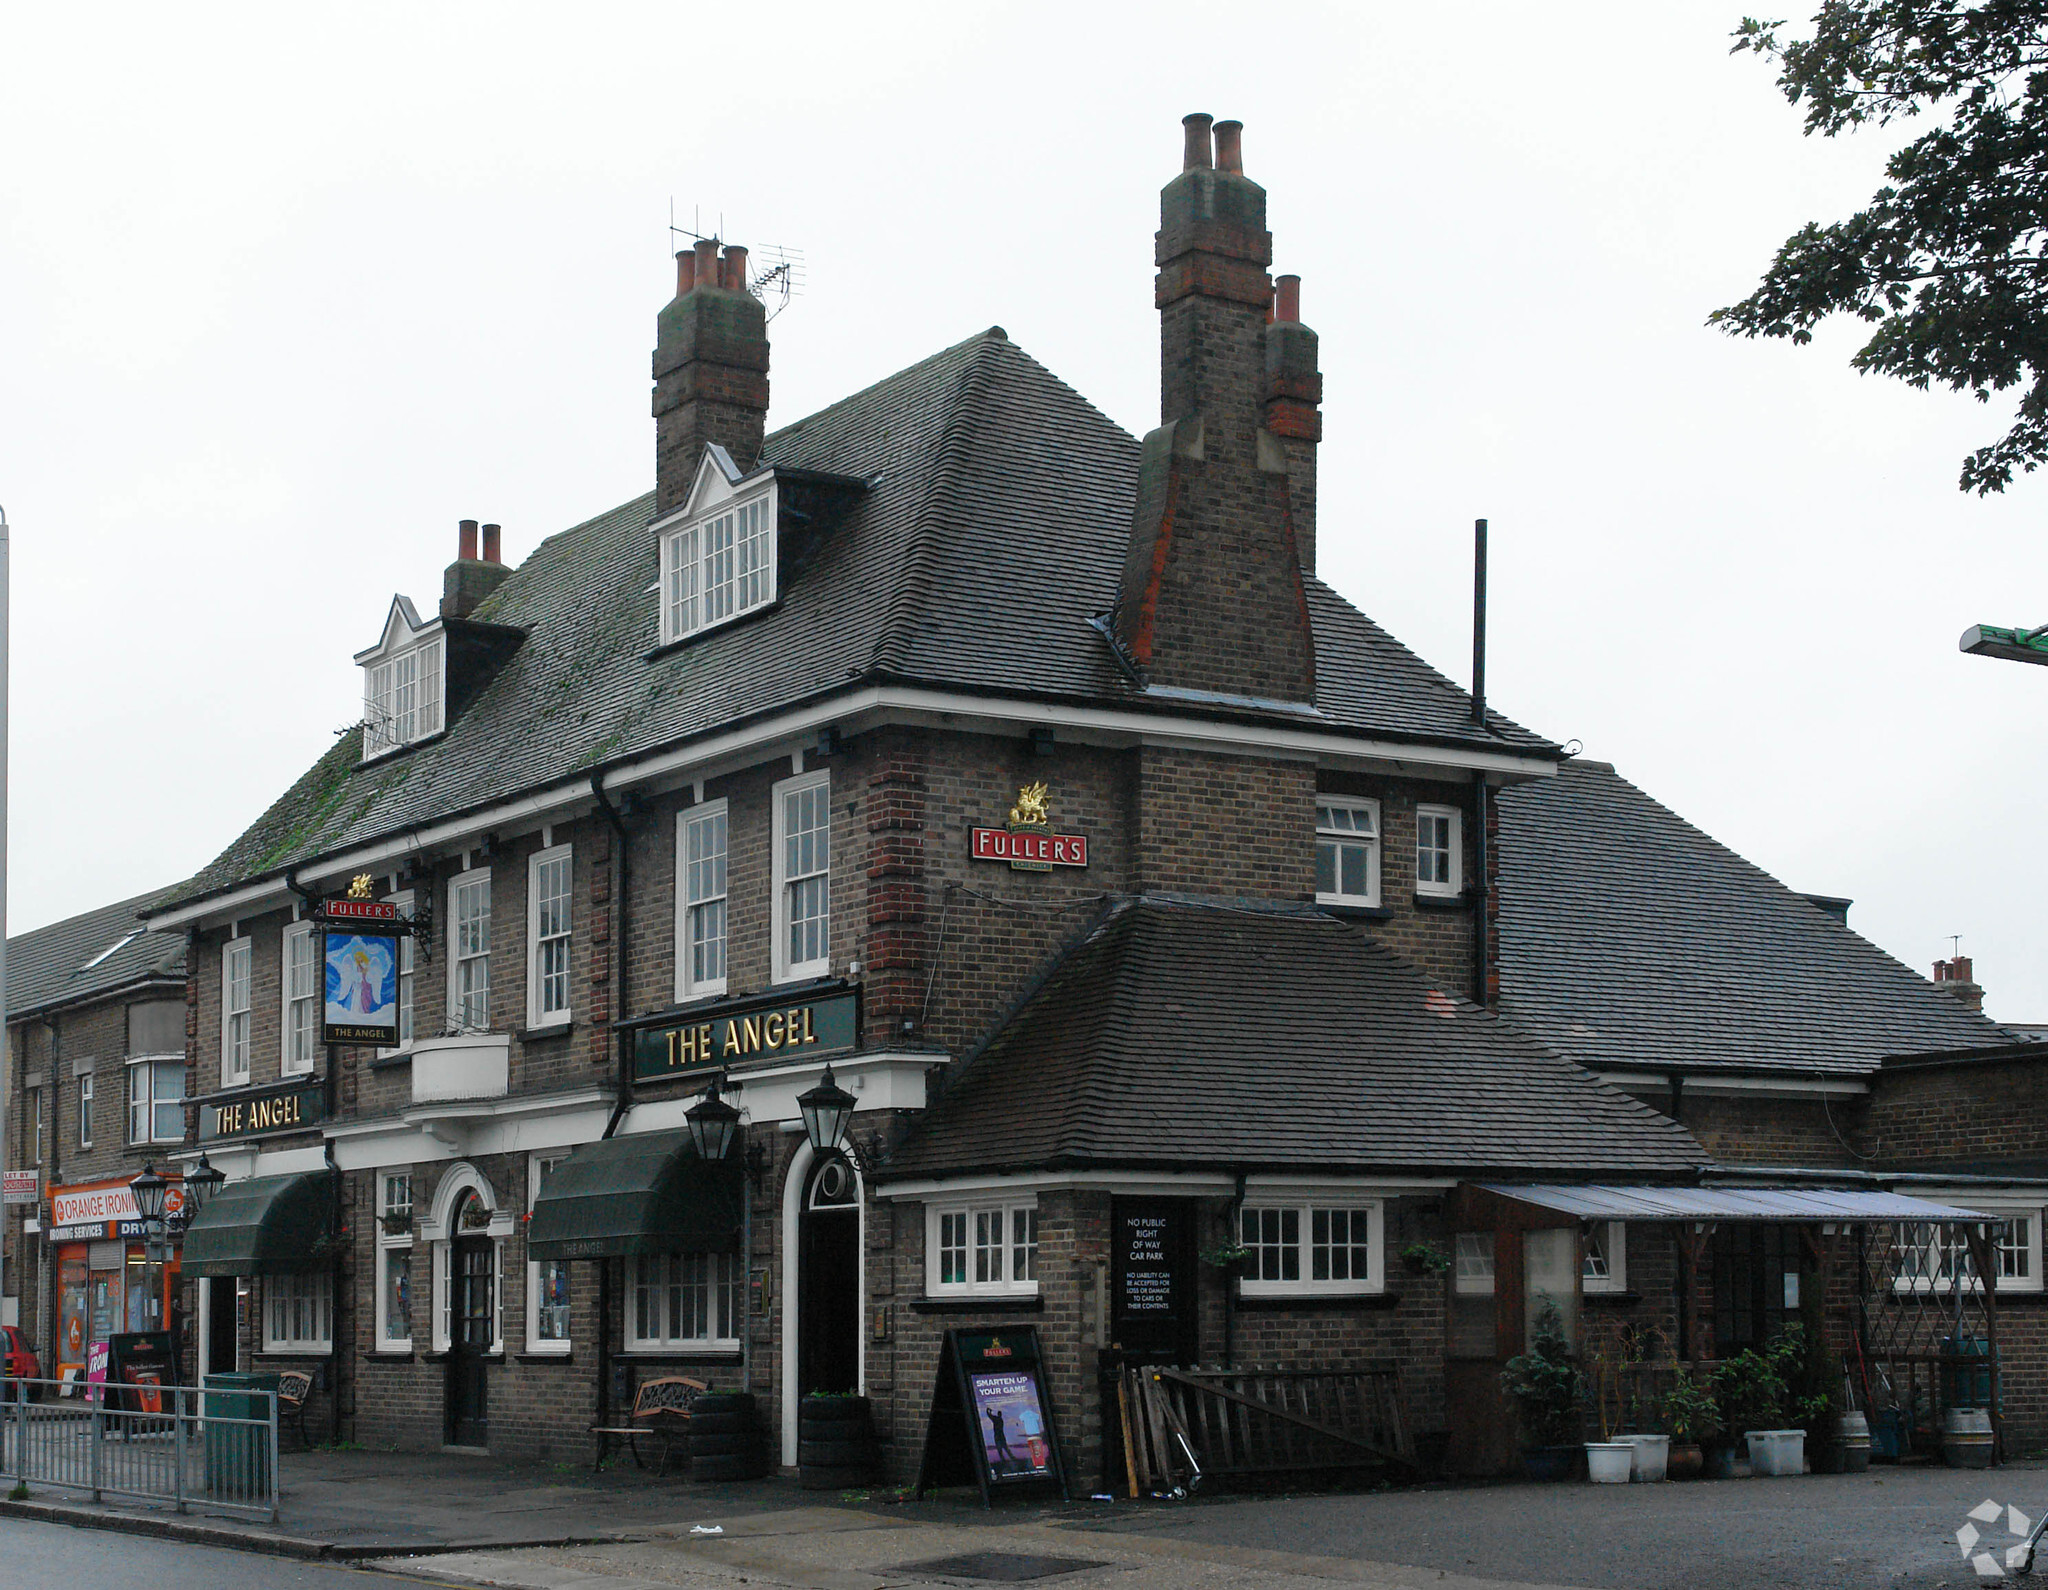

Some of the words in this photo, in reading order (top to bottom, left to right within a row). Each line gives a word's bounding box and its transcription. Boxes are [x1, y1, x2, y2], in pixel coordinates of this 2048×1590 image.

[979, 831, 1081, 862] FULLER'S
[330, 902, 392, 917] FULLER'S
[335, 1028, 352, 1037] THE
[355, 1029, 385, 1038] ANGEL
[666, 1024, 711, 1065] THE
[723, 1007, 815, 1056] ANGEL
[216, 1104, 242, 1134] THE
[248, 1095, 300, 1129] ANGEL
[65, 1196, 104, 1219] ORANGE
[105, 1192, 139, 1215] IRONIN
[121, 1222, 148, 1235] DRY
[1127, 1219, 1140, 1227] NO
[1141, 1219, 1166, 1227] PUBLIC
[49, 1228, 73, 1240] IRONING
[74, 1223, 102, 1238] SERVICES
[1136, 1229, 1158, 1238] RIGHT
[1132, 1241, 1143, 1249] OF
[1145, 1241, 1161, 1249] WAY
[1129, 1252, 1144, 1260] CAR
[1146, 1252, 1164, 1260] PARK
[976, 1377, 1015, 1387] SMARTEN
[1016, 1376, 1028, 1385] UP
[979, 1387, 1001, 1396] YOUR
